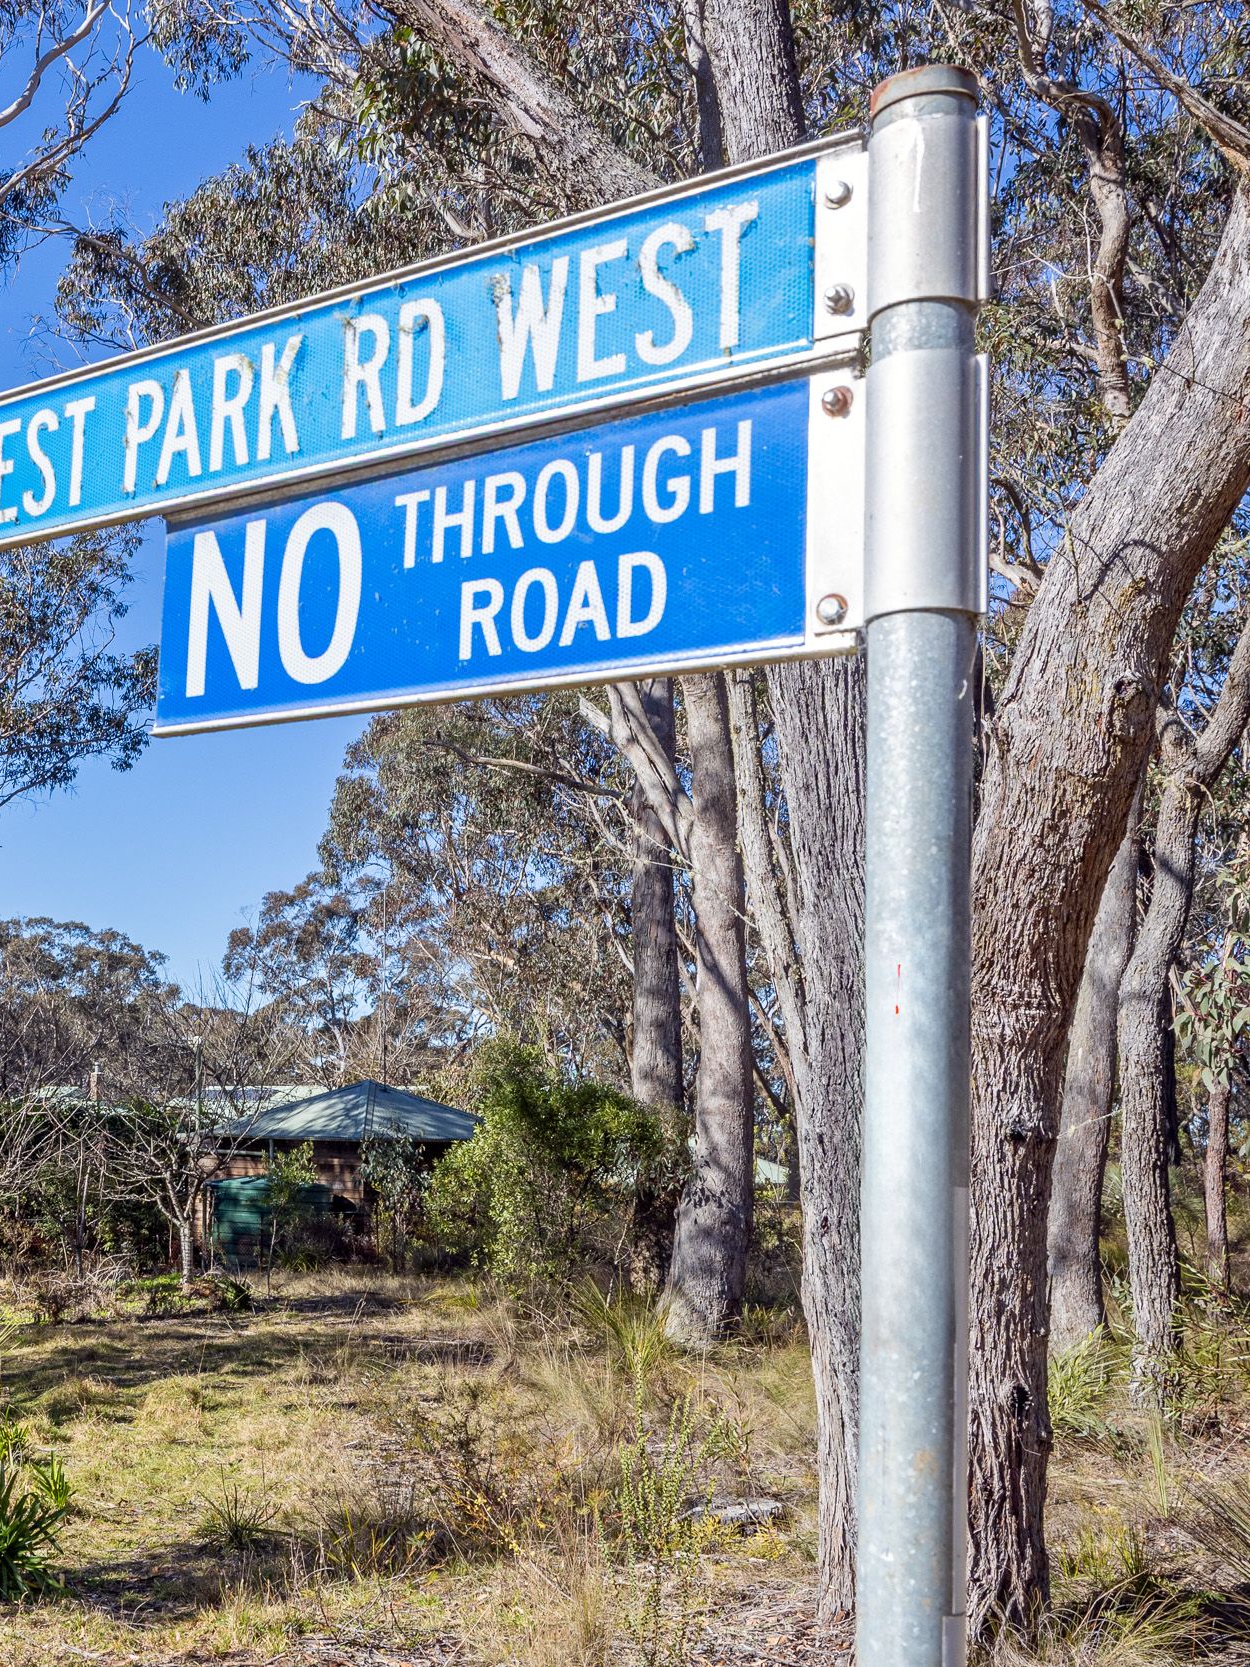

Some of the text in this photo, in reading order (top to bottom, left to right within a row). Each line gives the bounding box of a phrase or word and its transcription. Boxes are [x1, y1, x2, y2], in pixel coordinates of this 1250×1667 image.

[123, 333, 302, 493] PARK
[340, 297, 445, 439] RD
[490, 201, 759, 401] WEST
[185, 418, 753, 697] NO THROUGH
[458, 551, 667, 661] ROAD
